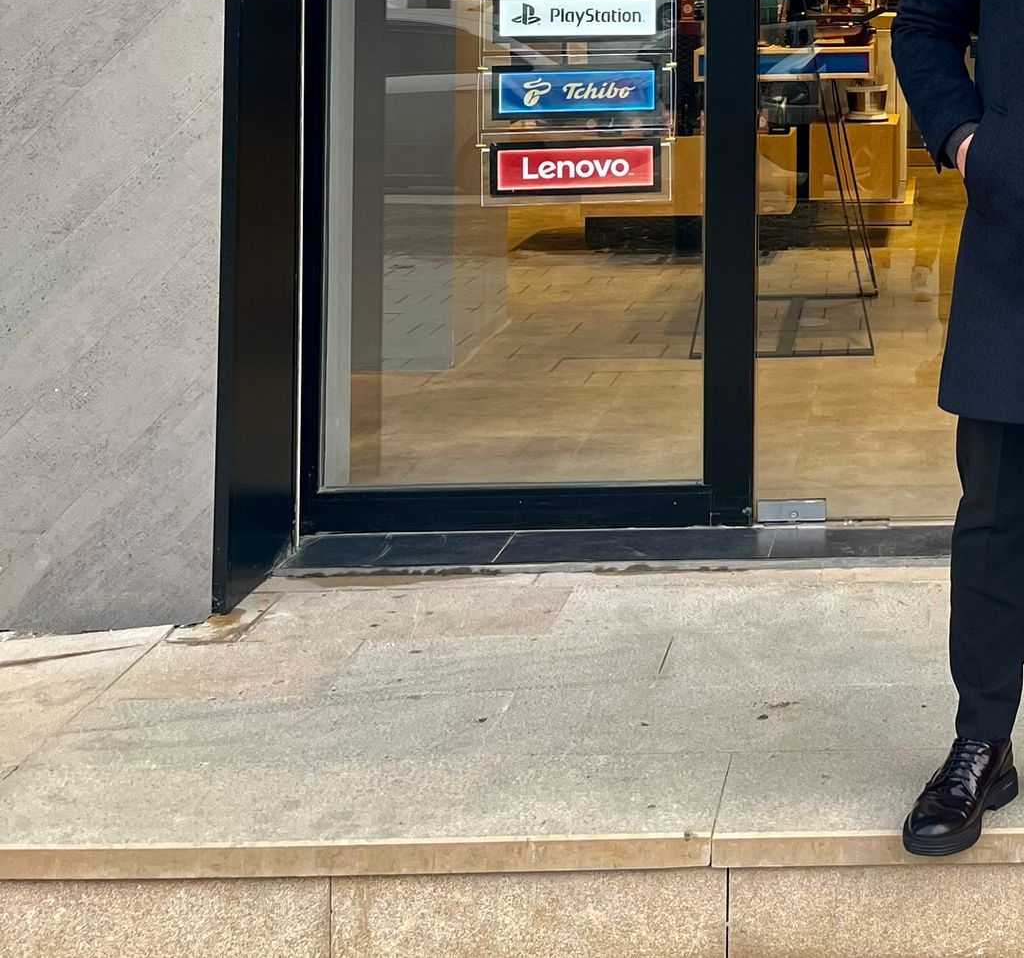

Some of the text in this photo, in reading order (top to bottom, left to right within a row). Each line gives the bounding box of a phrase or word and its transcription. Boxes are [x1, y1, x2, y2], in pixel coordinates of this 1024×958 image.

[550, 7, 642, 27] PlayStation
[562, 82, 636, 99] Tchibo
[522, 157, 630, 180] Lenovo
